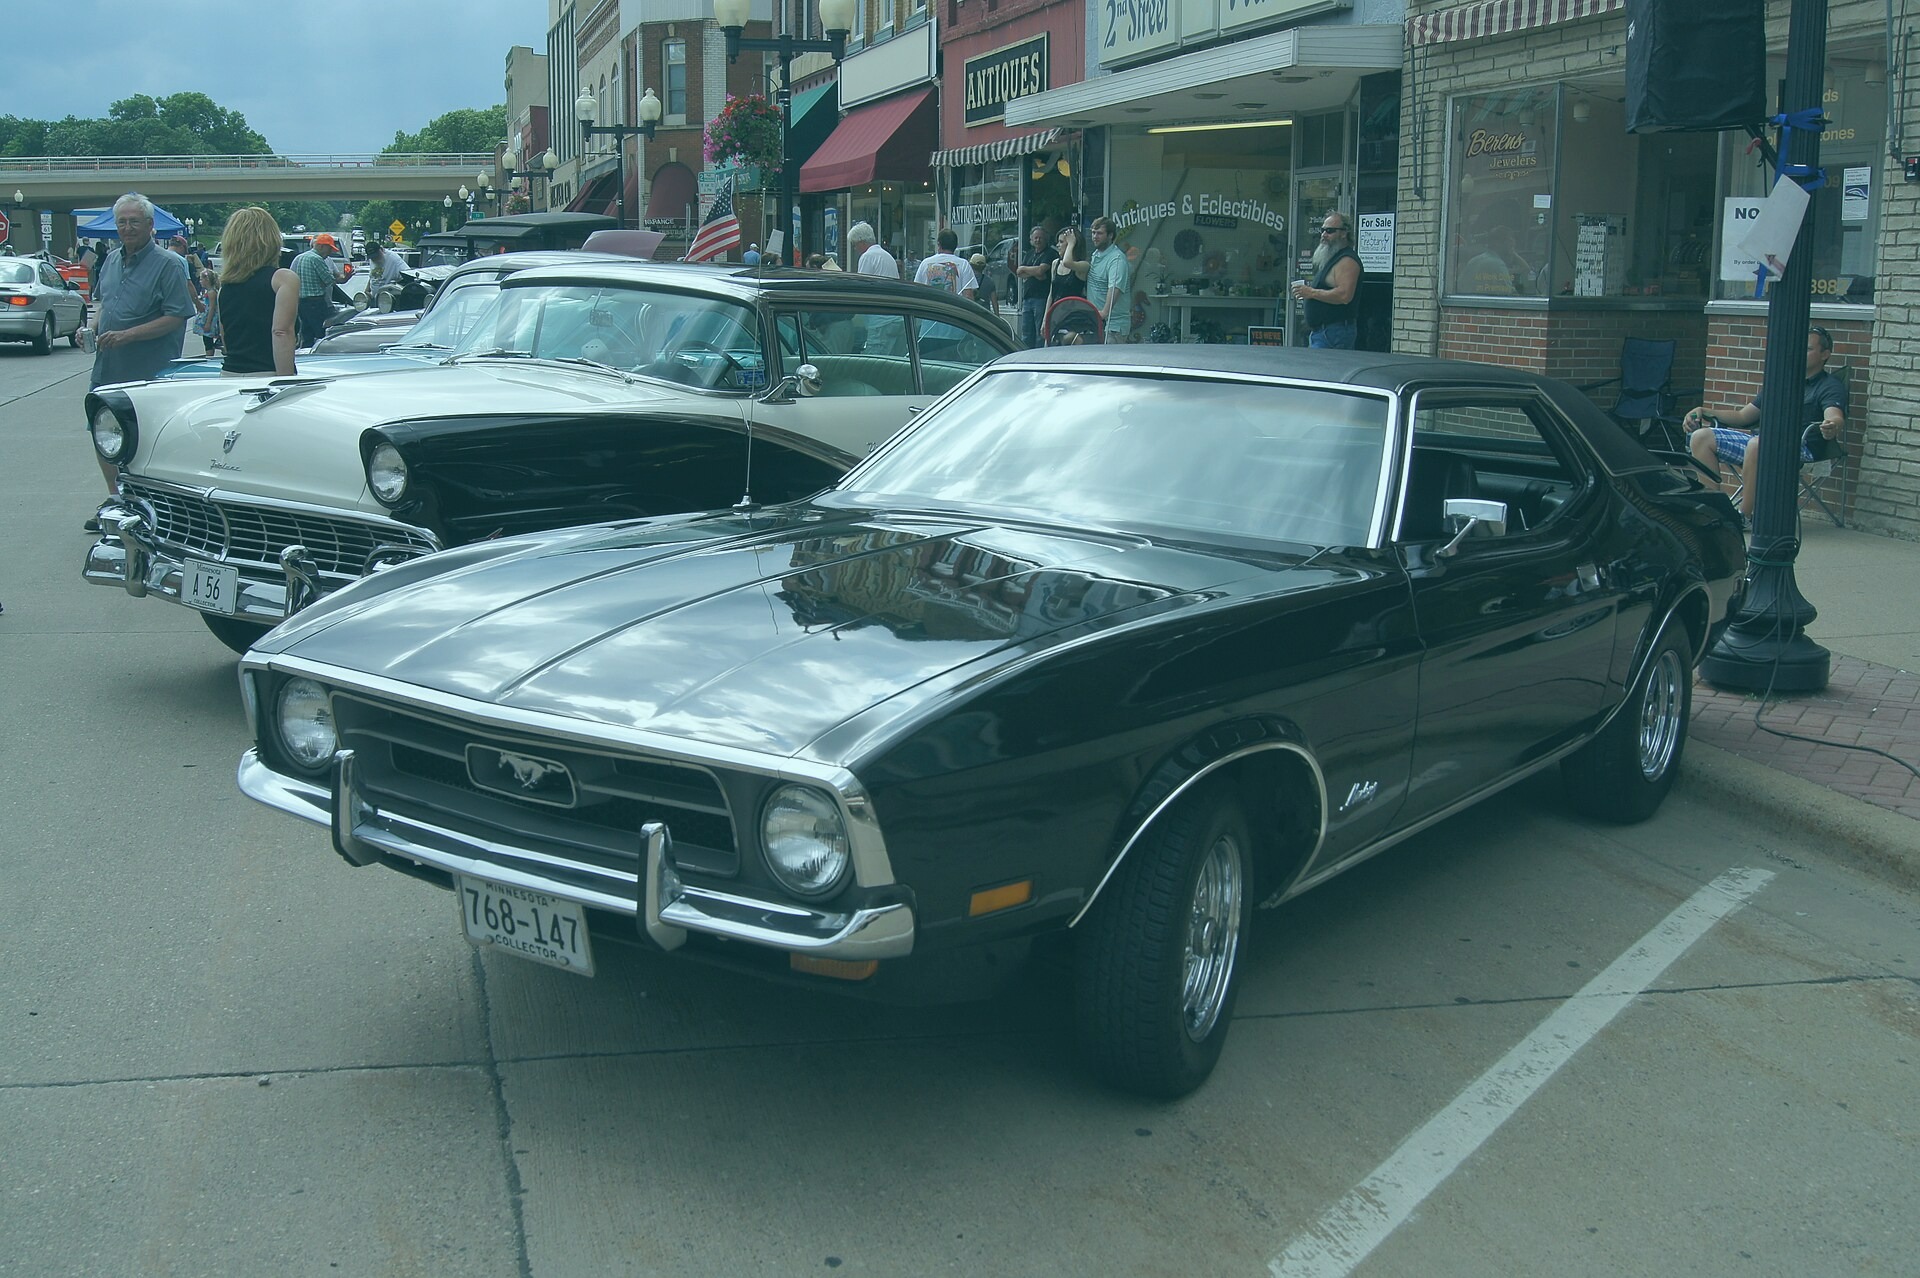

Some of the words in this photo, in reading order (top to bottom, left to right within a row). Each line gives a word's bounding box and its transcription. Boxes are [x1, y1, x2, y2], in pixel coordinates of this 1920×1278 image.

[966, 51, 1040, 110] ANTIQUES
[1466, 129, 1526, 158] Berens
[1490, 155, 1537, 168] Jewelers
[953, 204, 982, 225] ANTIQUES
[1112, 200, 1176, 229] Antiques
[1181, 194, 1194, 215] &
[1199, 193, 1285, 232] Eclectibles
[1195, 215, 1237, 227] FLOWERS
[1361, 217, 1374, 228] For
[1375, 217, 1392, 228] Sale
[1735, 208, 1760, 219] NO
[192, 573, 199, 596] A
[205, 575, 220, 601] 56
[486, 882, 549, 908] MINNESOTA
[465, 887, 578, 954] 768-147
[495, 933, 558, 960] COLLECTOR
